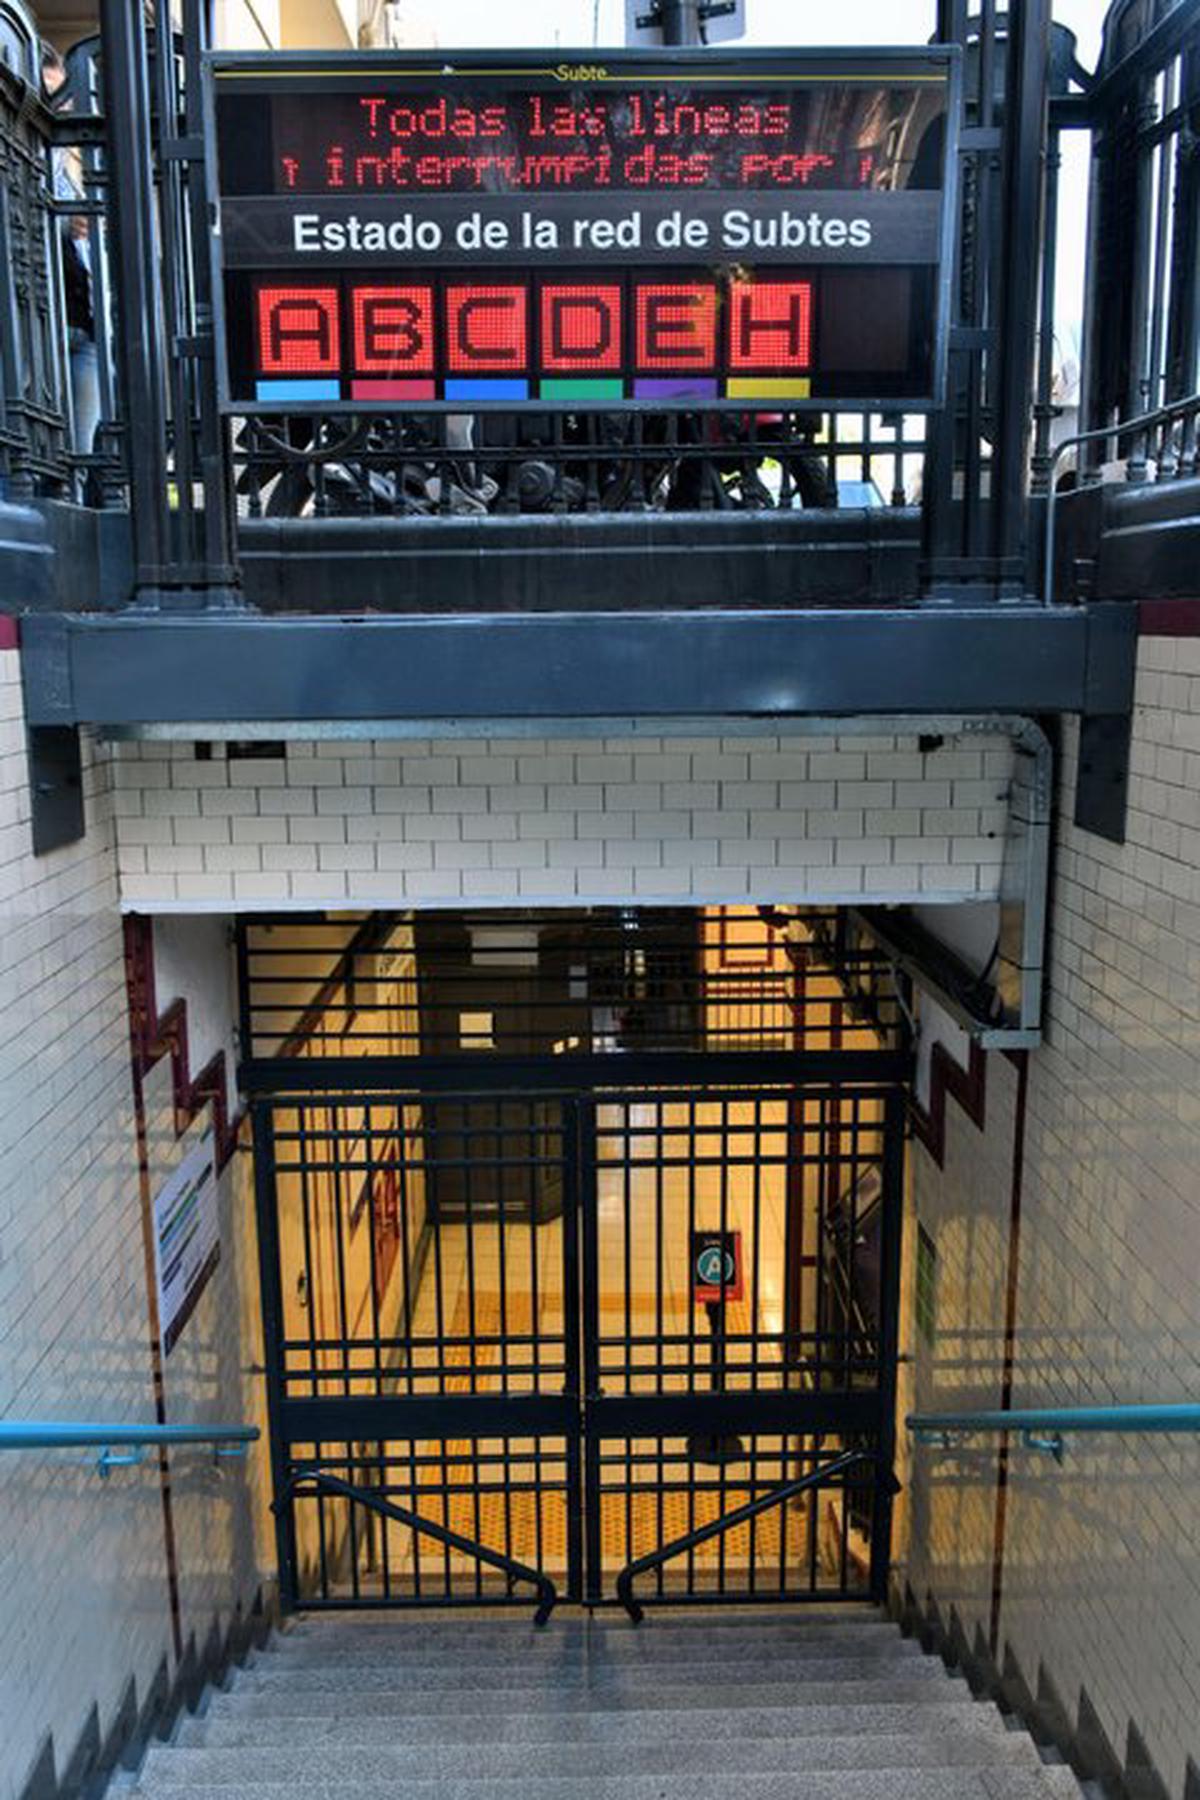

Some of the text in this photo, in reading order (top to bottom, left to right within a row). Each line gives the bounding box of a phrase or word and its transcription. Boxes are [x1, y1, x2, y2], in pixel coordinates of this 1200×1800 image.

[557, 64, 607, 81] Subte
[360, 98, 506, 138] Todas
[529, 97, 606, 136] las
[326, 146, 713, 186] interrumpidas
[741, 154, 833, 184] por
[293, 210, 872, 251] Estado de la red de Subtes
[269, 294, 801, 361] A B C D E H
